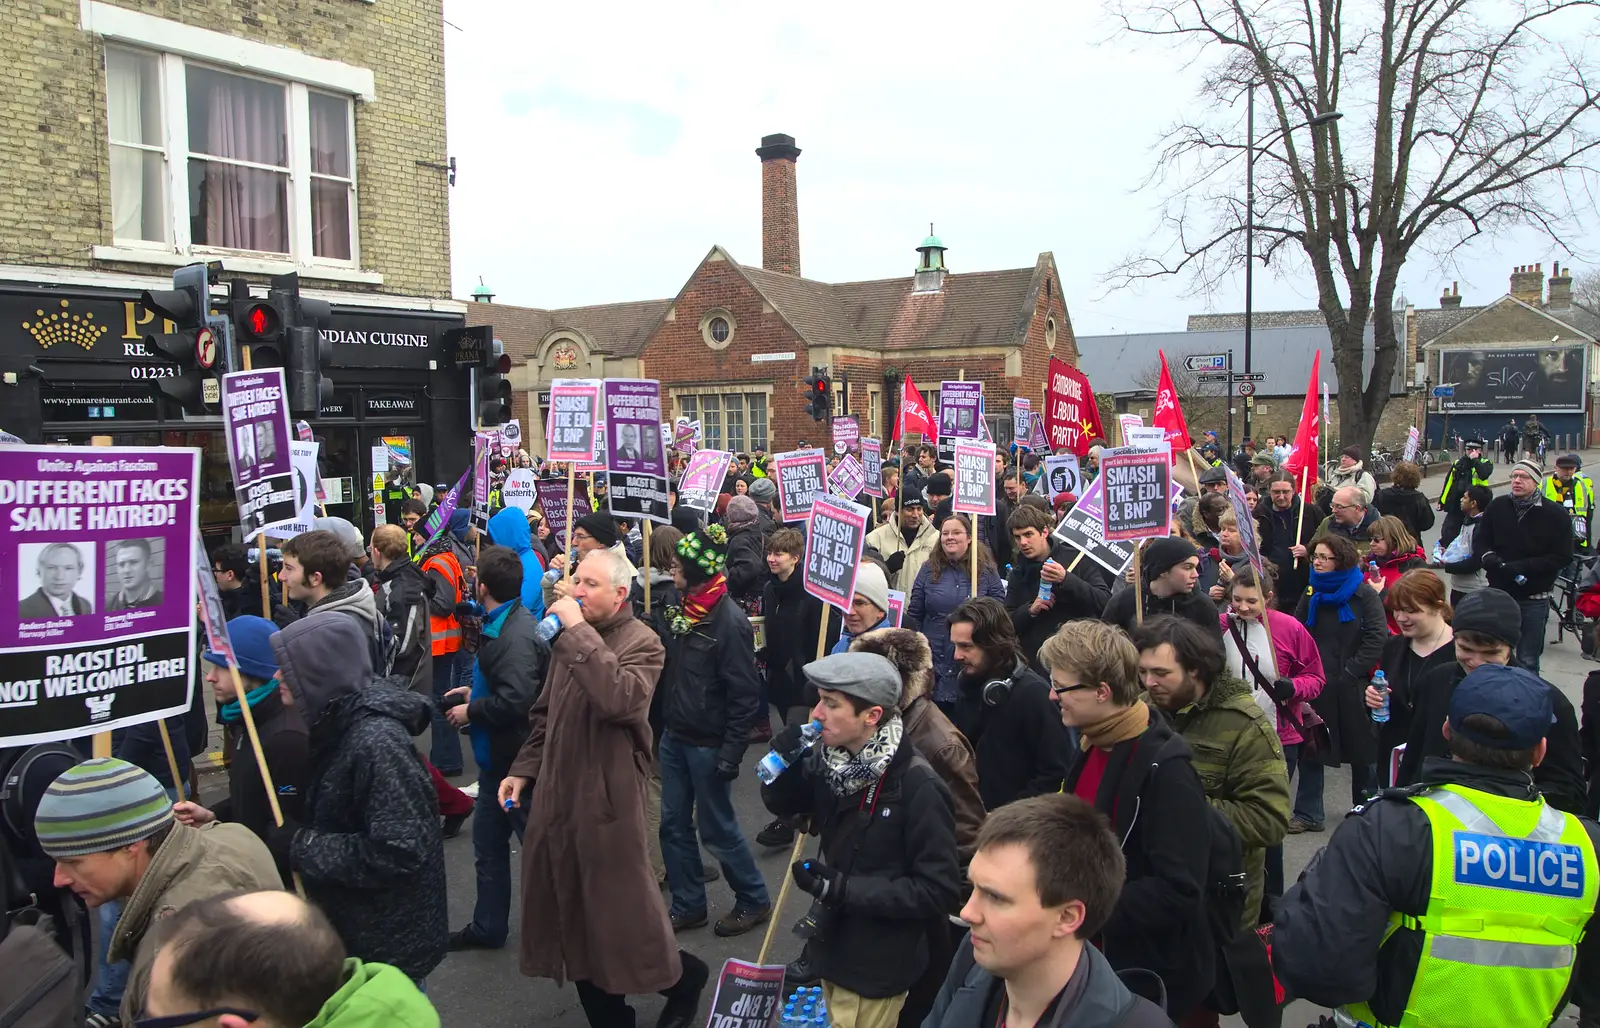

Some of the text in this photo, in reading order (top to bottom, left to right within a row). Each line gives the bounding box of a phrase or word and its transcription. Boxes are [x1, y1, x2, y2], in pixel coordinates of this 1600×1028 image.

[318, 330, 429, 348] NDIAN CUISINE
[131, 367, 174, 379] 01223
[1487, 366, 1536, 391] sky
[43, 396, 154, 406] www.pranarestaurant.co.uk
[955, 398, 977, 406] HATRED!
[966, 390, 980, 398] FACES
[320, 405, 343, 413] IVERY
[368, 400, 415, 410] TAKEAWAY
[554, 396, 588, 412] SMASH
[554, 412, 592, 428] THE EDL
[563, 428, 584, 443] BNP
[1052, 424, 1079, 448] PARTY
[37, 459, 158, 475] Unite Against Fascism
[958, 454, 986, 470] SMASH
[781, 464, 816, 481] SMASH
[958, 468, 990, 485] THE EDL
[1106, 465, 1156, 486] SMASH
[0, 479, 189, 505] DIFFERENT FACES
[511, 480, 531, 489] No to
[782, 477, 823, 494] THE EDL
[958, 483, 984, 498] & BNP
[1107, 483, 1164, 503] THE EDL
[505, 488, 537, 499] austerity
[785, 493, 794, 506] &
[541, 497, 554, 508] No
[560, 499, 589, 510] raism,
[1108, 501, 1153, 521] & BNP
[10, 503, 177, 532] SAME HATRED!
[545, 507, 580, 519] fascim
[293, 523, 308, 533] HATE
[813, 514, 854, 541] SMASH
[1064, 517, 1081, 530] NOT
[1108, 543, 1130, 561] HERE!
[812, 533, 854, 568] THE EDL
[809, 553, 844, 582] & BNP
[46, 643, 148, 677] RACIST EDL
[0, 657, 187, 703] NOT WELCOME HERE!
[1460, 839, 1579, 889] POLICE
[731, 993, 775, 1018] & BNP
